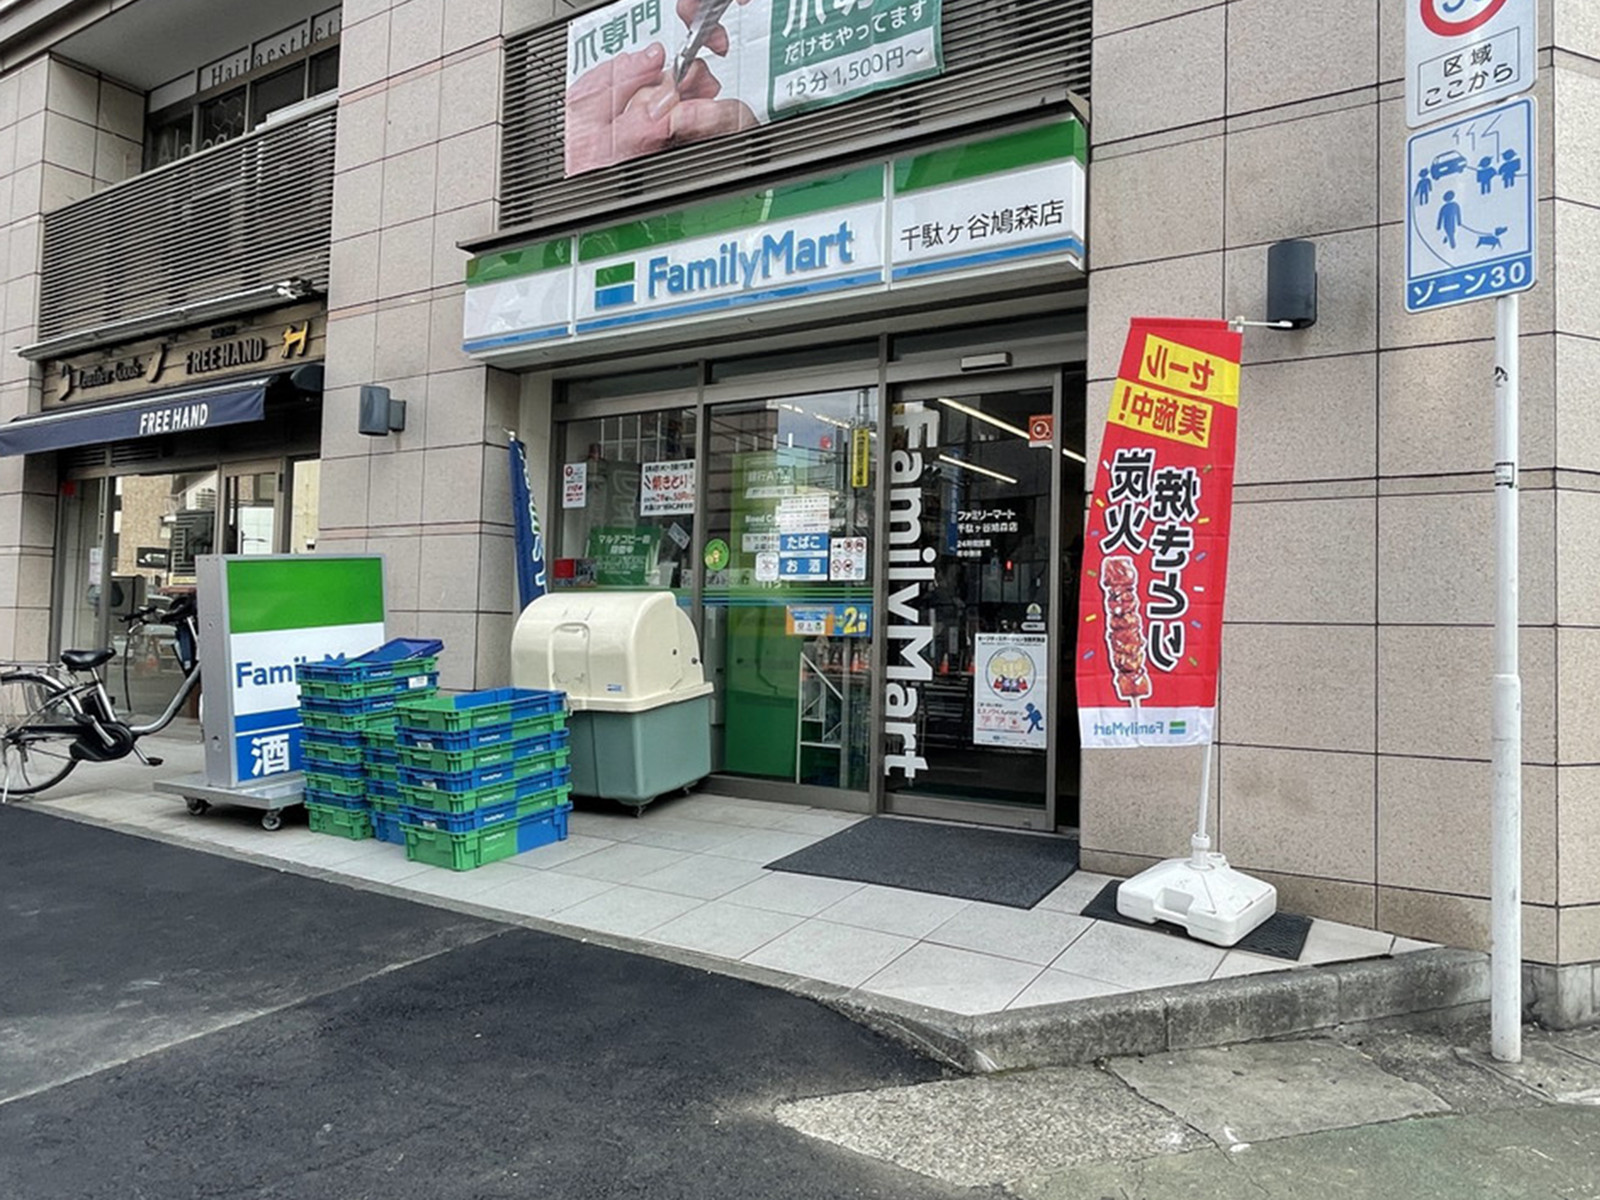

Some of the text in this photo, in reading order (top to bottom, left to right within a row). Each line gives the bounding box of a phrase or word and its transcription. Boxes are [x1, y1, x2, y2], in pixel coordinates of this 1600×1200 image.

[573, 0, 662, 75] 爪専門
[783, 0, 927, 65] だけもやってます
[1444, 43, 1493, 77] 区域
[1425, 63, 1513, 107] ここから
[648, 220, 854, 299] FamilyMart
[1413, 262, 1526, 306] ゾーン30
[786, 536, 821, 550] たばこ
[885, 401, 940, 779] FamilyMart
[251, 733, 290, 777] 酒
